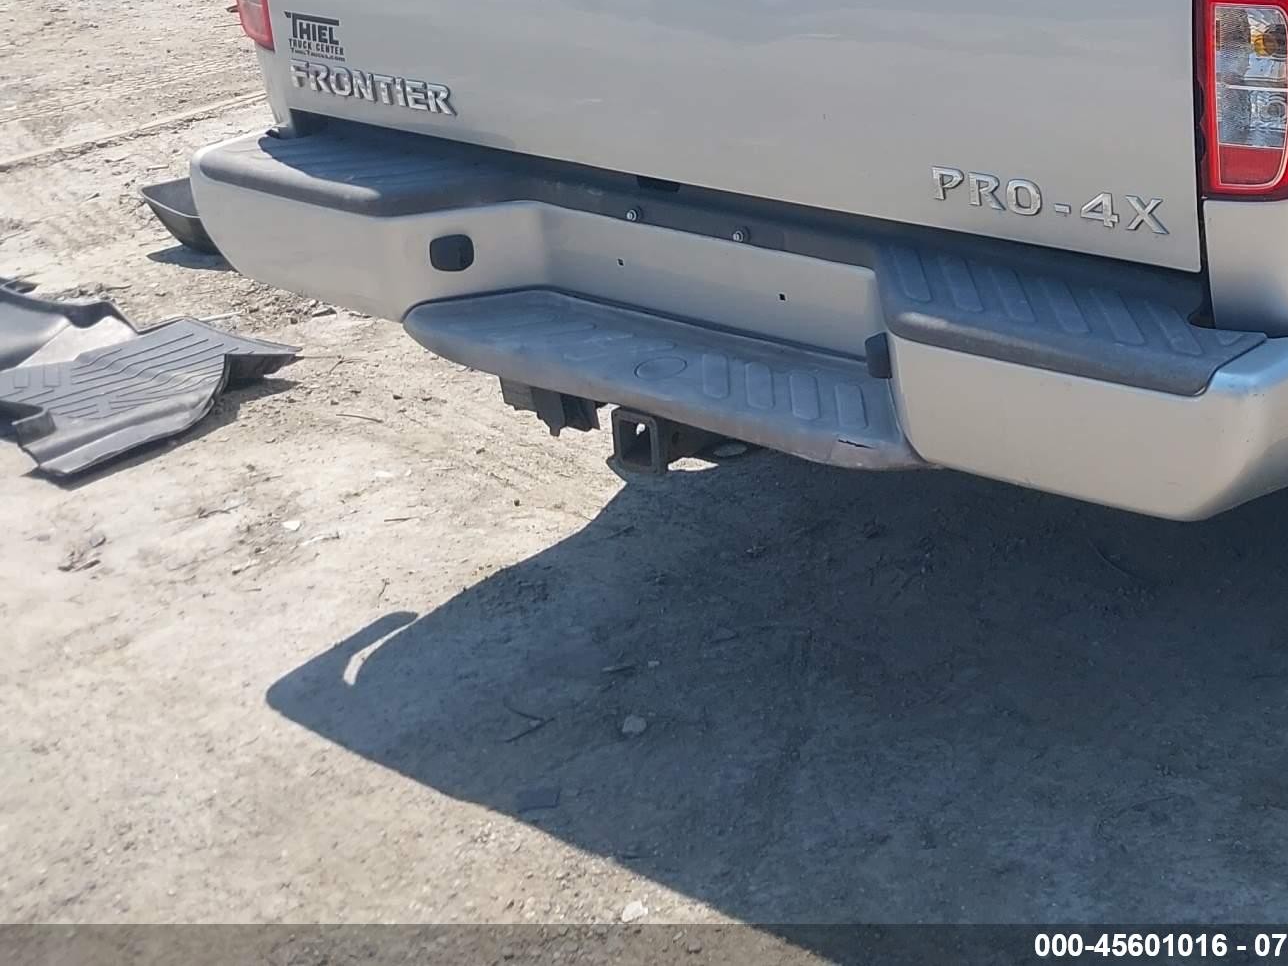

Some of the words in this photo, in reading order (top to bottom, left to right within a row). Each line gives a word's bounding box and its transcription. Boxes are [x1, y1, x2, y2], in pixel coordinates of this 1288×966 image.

[284, 10, 340, 46] THIEL
[288, 38, 313, 51] TRUCK
[315, 42, 345, 56] CENTER
[290, 58, 458, 116] FRONTIER
[931, 165, 1170, 236] PRO-4X
